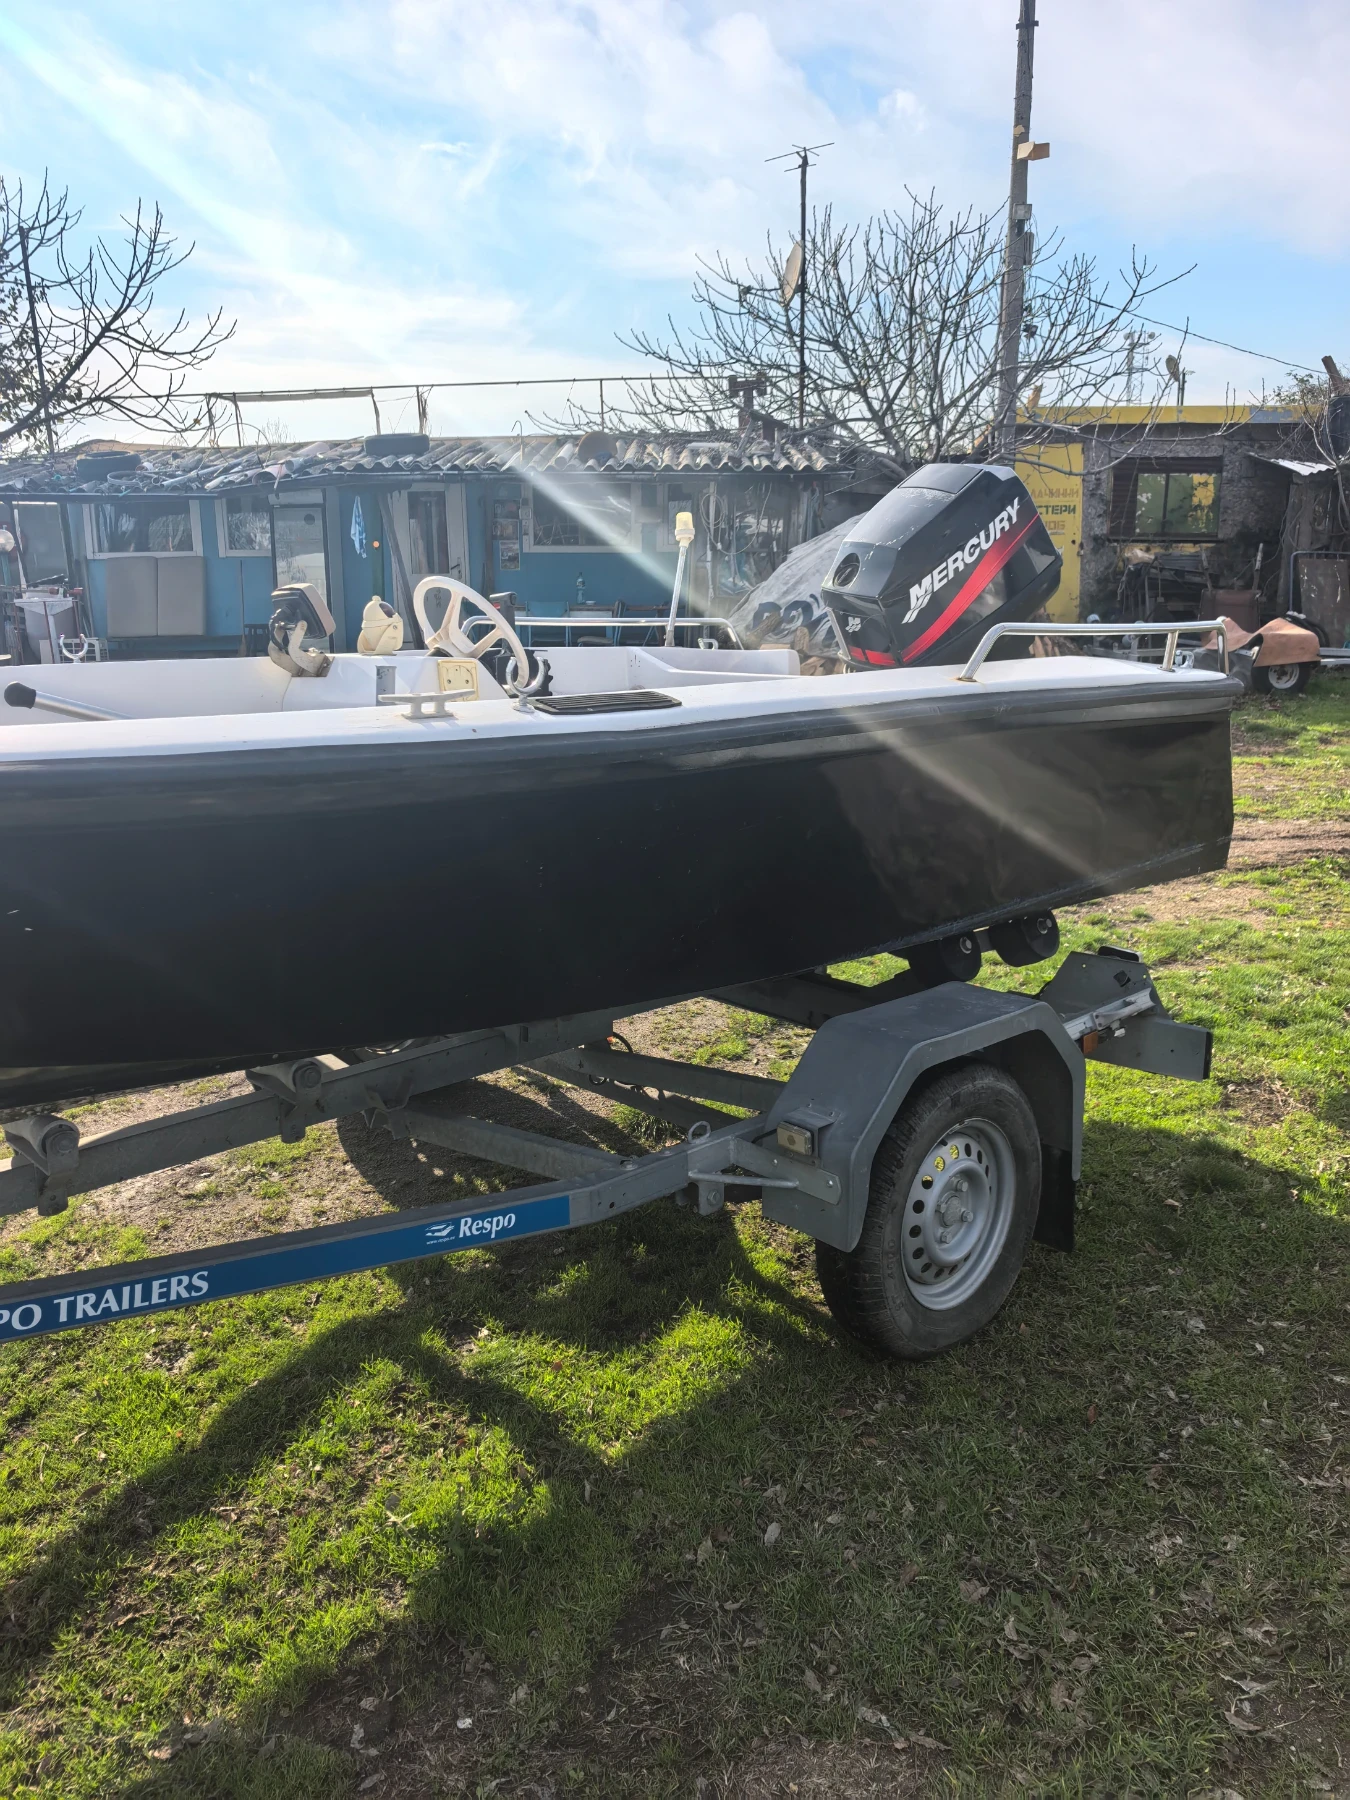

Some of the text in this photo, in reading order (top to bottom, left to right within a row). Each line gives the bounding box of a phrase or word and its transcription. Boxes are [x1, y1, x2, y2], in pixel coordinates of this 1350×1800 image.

[901, 497, 1020, 624] MERCURY
[459, 1213, 516, 1239] Respo
[54, 1270, 209, 1323] TRAILERS
